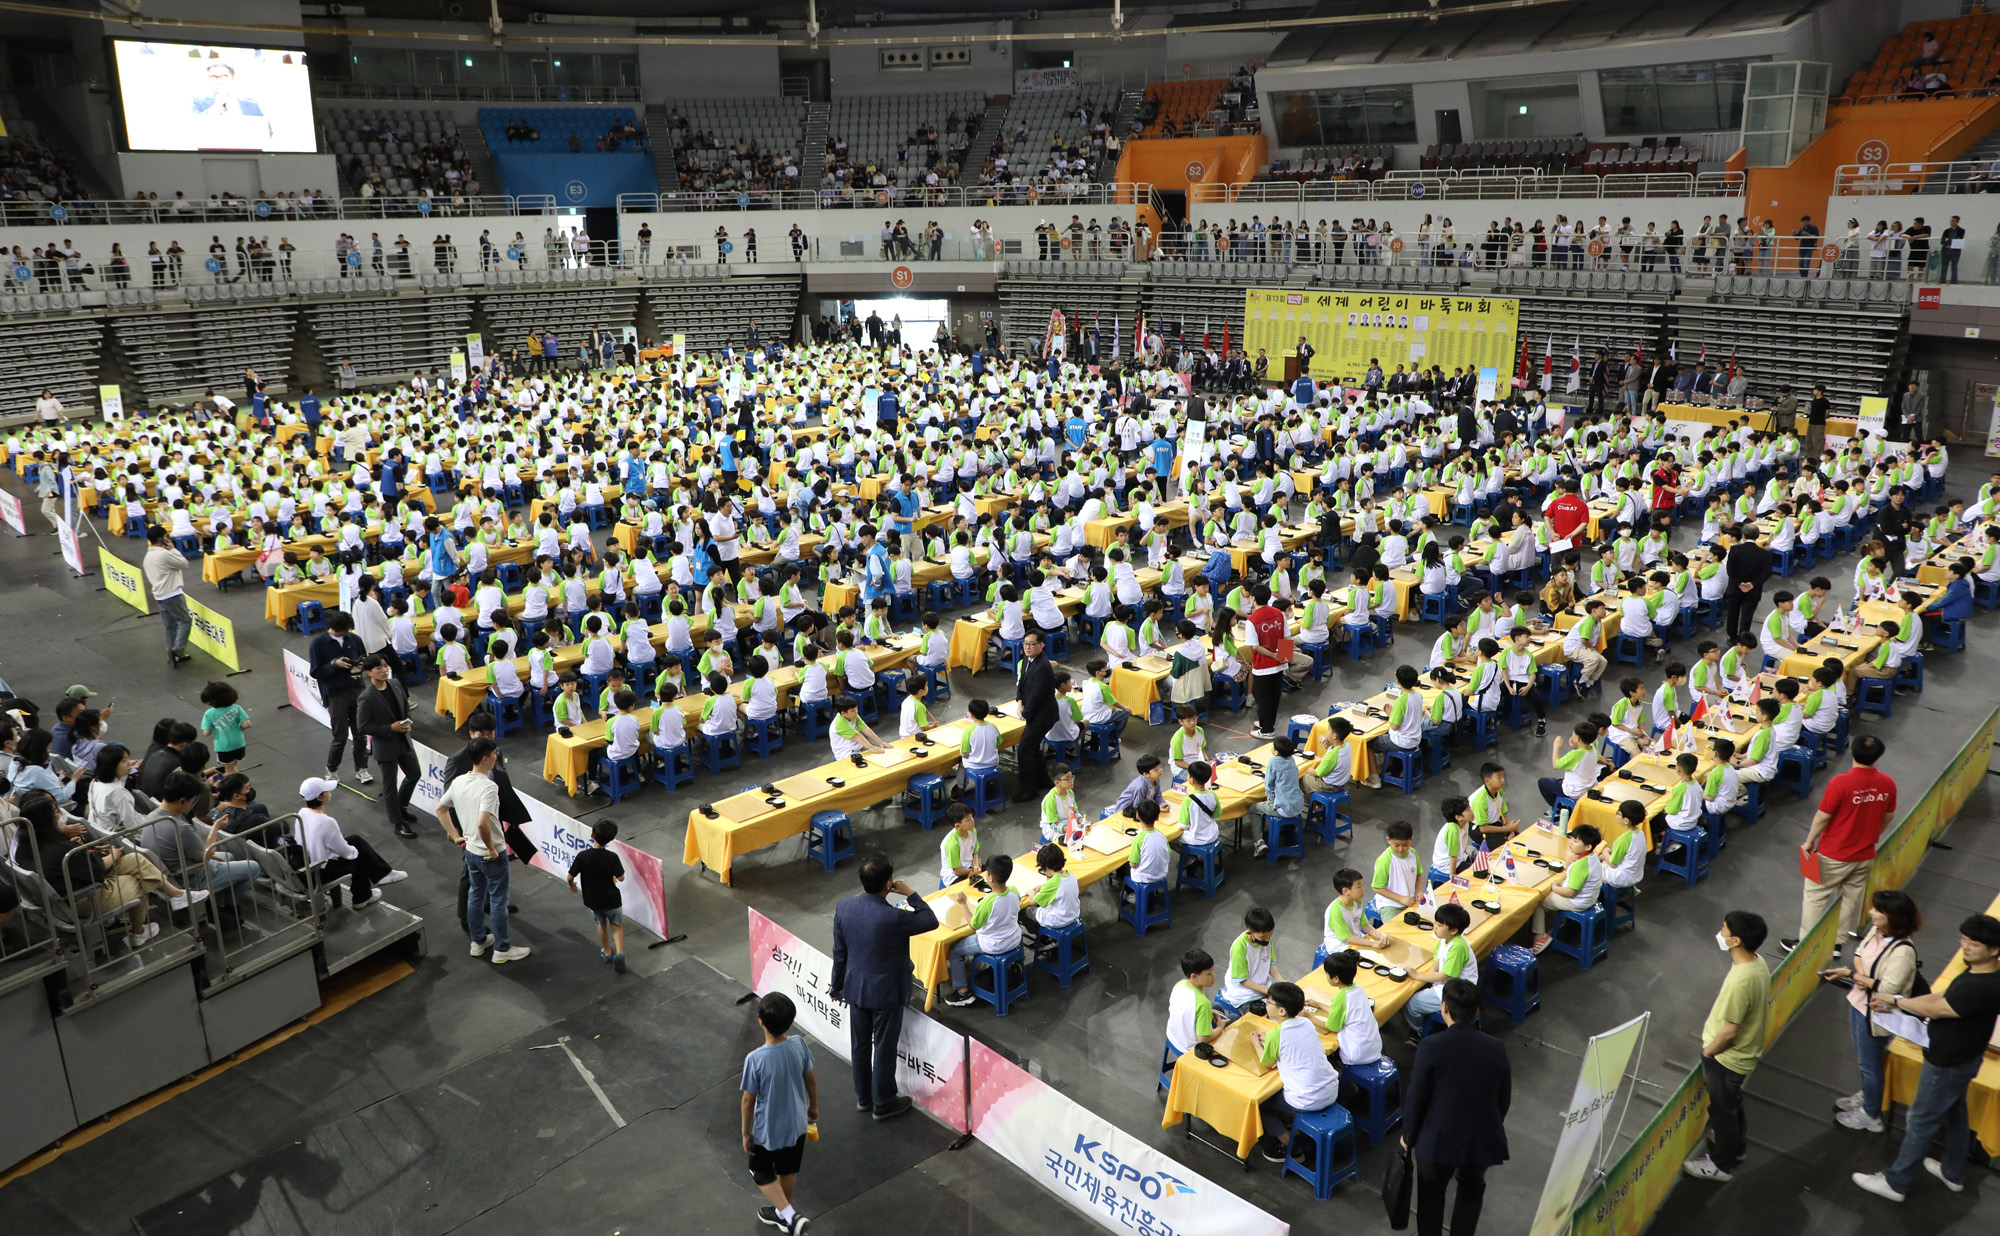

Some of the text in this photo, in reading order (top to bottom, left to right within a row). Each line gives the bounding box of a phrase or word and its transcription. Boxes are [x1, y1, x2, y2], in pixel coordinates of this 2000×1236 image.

[1863, 149, 1882, 161] S3
[1188, 166, 1200, 176] S2
[570, 185, 583, 195] E3
[896, 271, 907, 281] S1
[1266, 294, 1286, 303] 제13회
[1317, 295, 1349, 307] 세계
[1360, 296, 1409, 311] 어린이
[1420, 297, 1491, 315] 바둑대회
[1918, 294, 1940, 303] 소화전
[1860, 415, 1884, 423] 유단자부
[1852, 792, 1889, 805] Club A7
[772, 944, 819, 989] 생각!! 그
[796, 984, 842, 1029] 마지막을
[1074, 1133, 1162, 1200] KSPO
